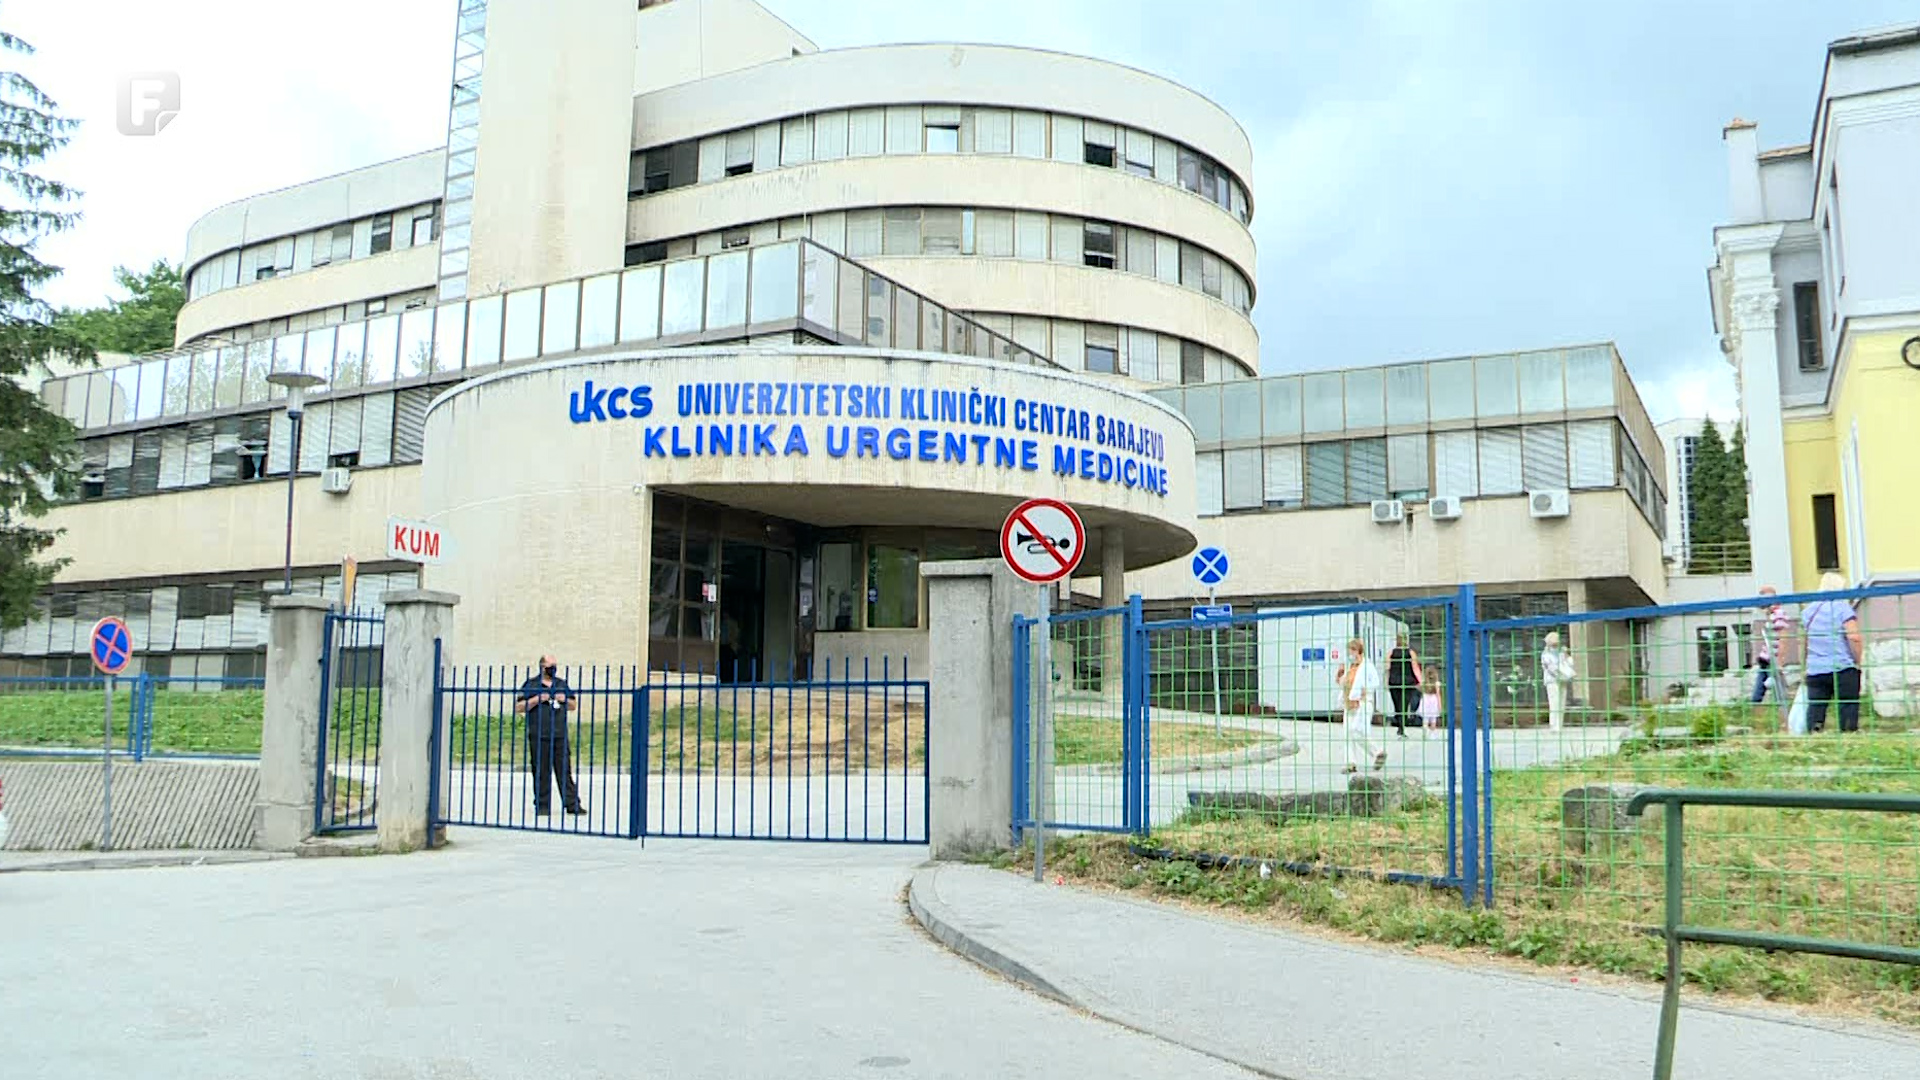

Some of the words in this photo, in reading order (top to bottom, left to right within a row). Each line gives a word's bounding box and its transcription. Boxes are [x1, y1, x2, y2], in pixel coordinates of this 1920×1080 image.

[678, 382, 890, 418] UNIVERZITETSKI
[901, 386, 1006, 428] KLINIČKI
[1014, 398, 1091, 441] CENTAR
[1096, 414, 1165, 462] SARAJEVO
[644, 423, 809, 458] KLINIKA
[826, 424, 1038, 471] URGENTNE
[1053, 444, 1168, 497] MEDICINE
[394, 524, 440, 557] KUM
